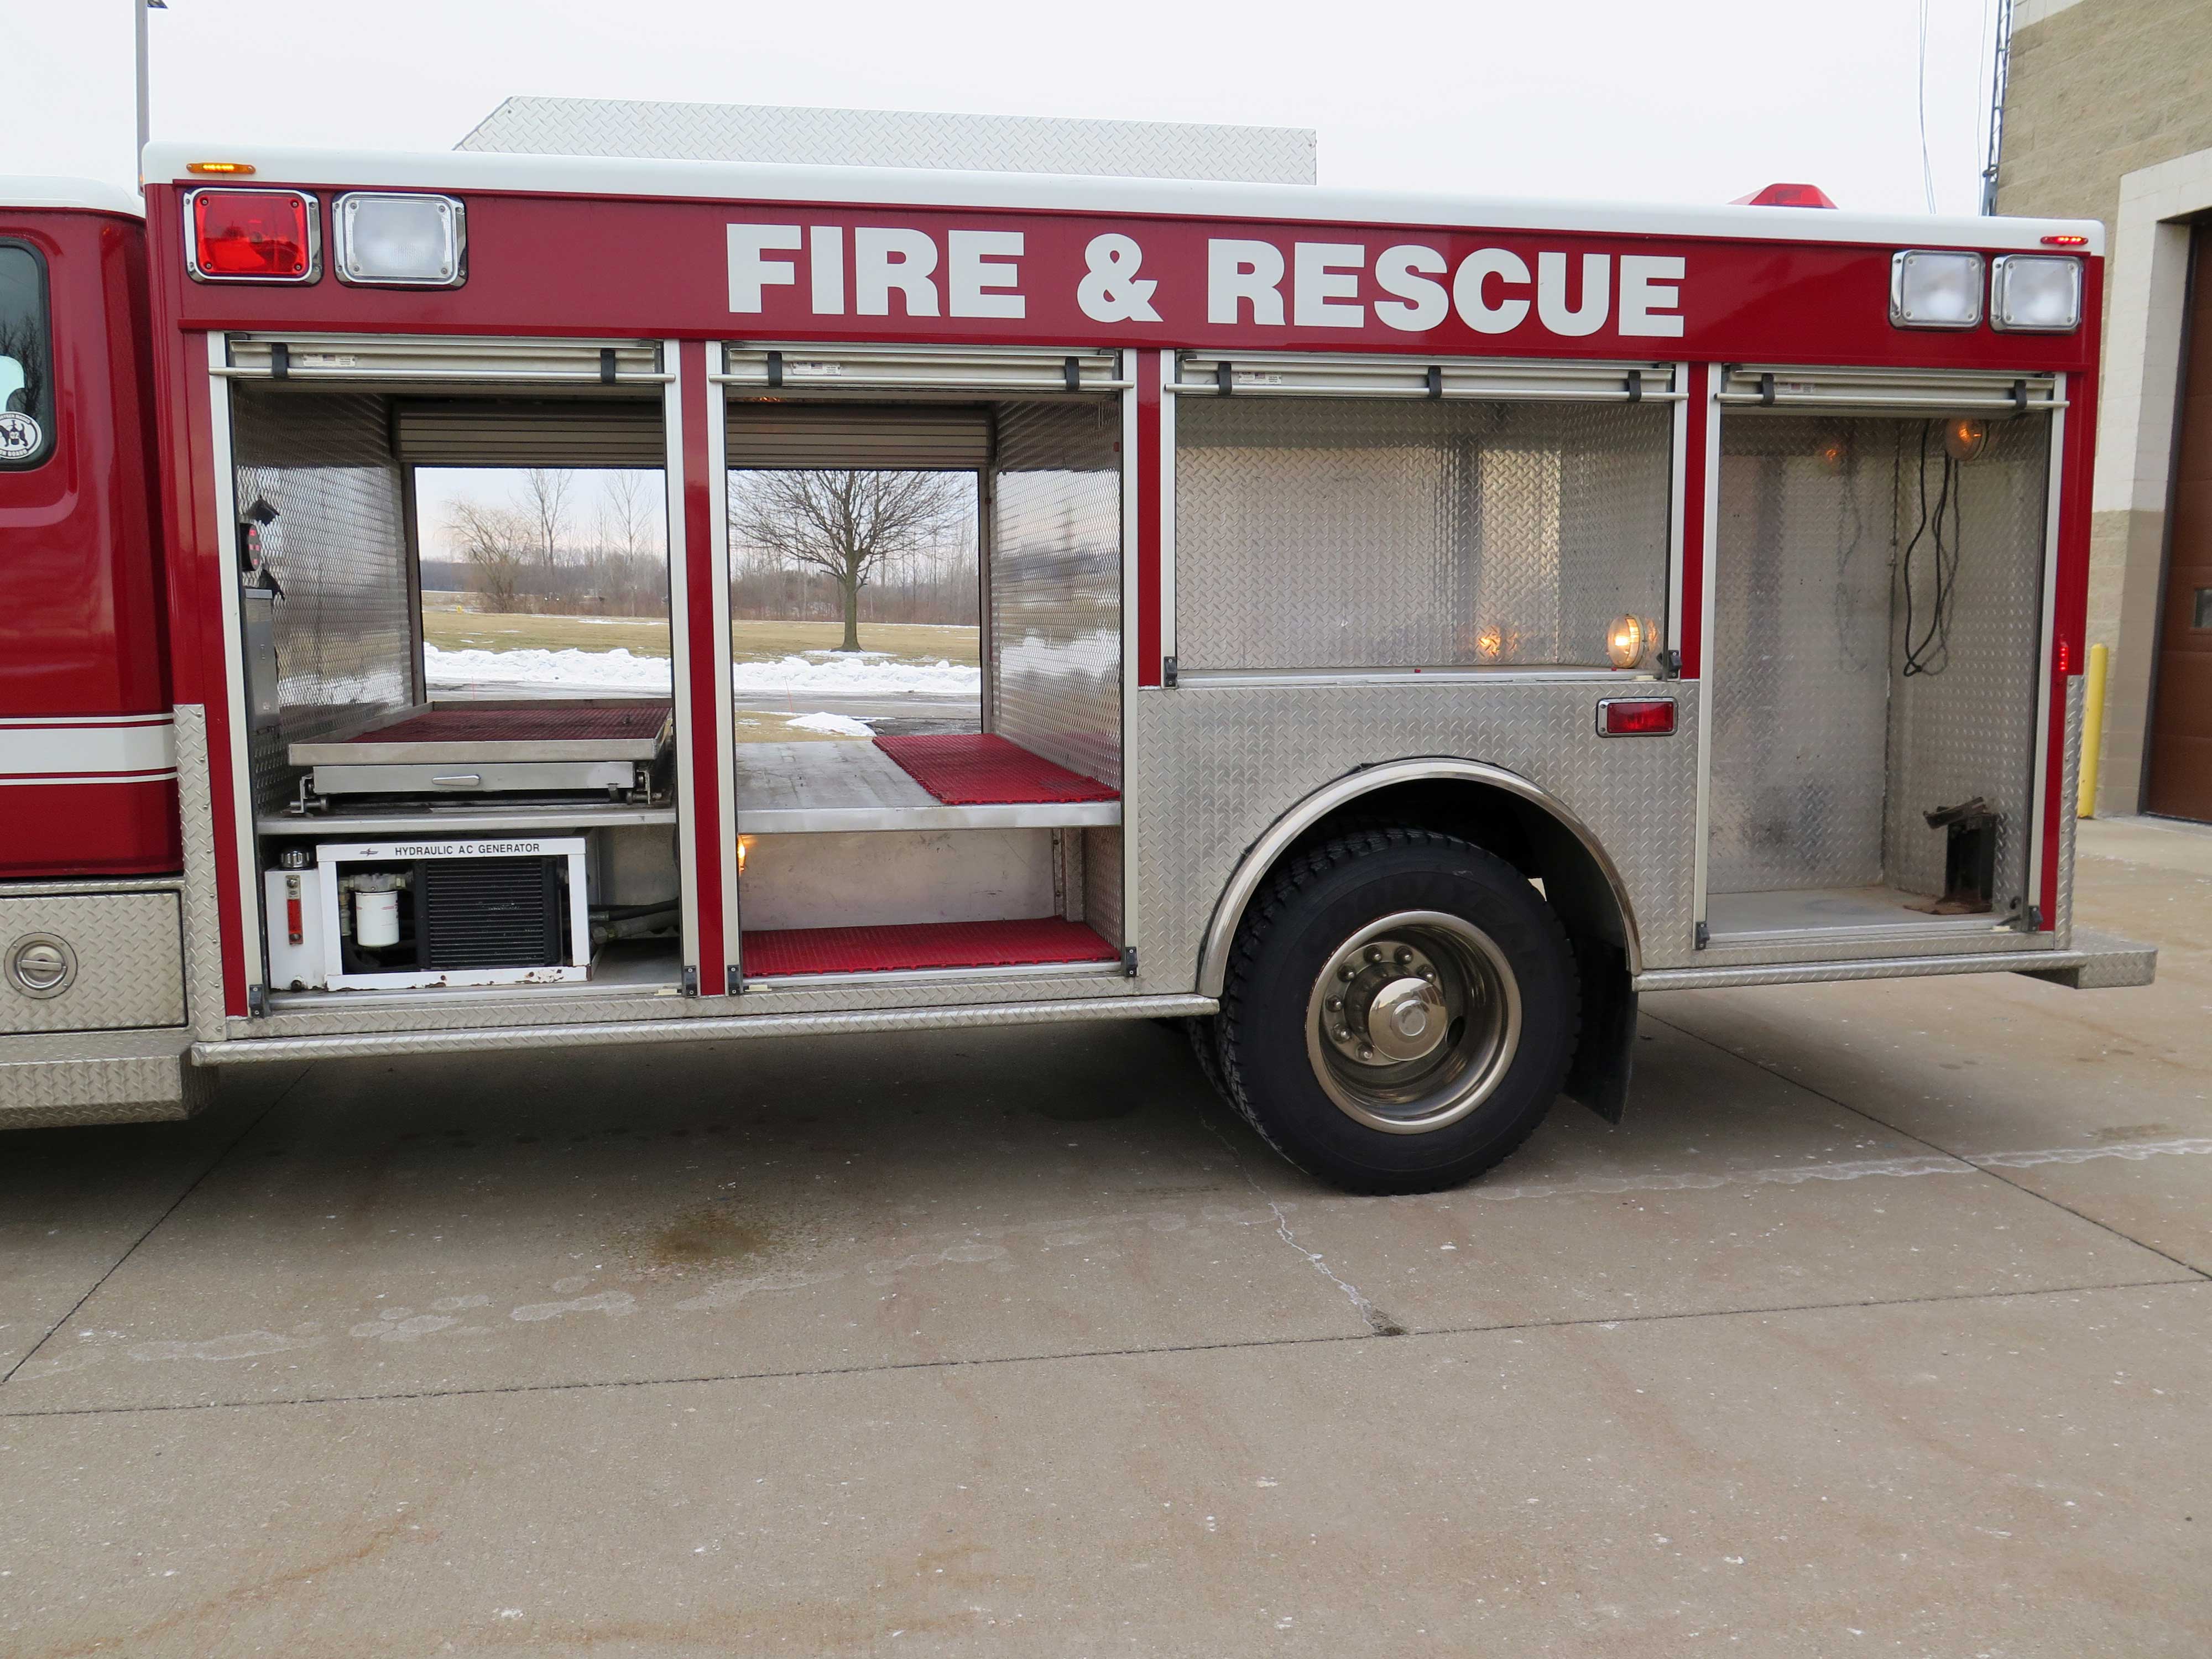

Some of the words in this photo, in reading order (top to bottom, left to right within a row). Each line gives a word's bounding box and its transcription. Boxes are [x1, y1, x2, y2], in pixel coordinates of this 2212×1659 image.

[726, 223, 1026, 319] FIRE
[1077, 232, 1164, 322] &
[1207, 238, 1686, 338] RESCUE
[8, 448, 28, 457] BOARD
[395, 846, 453, 856] HYDRAULIC
[458, 845, 474, 854] AC
[478, 843, 540, 854] GENERATOR
